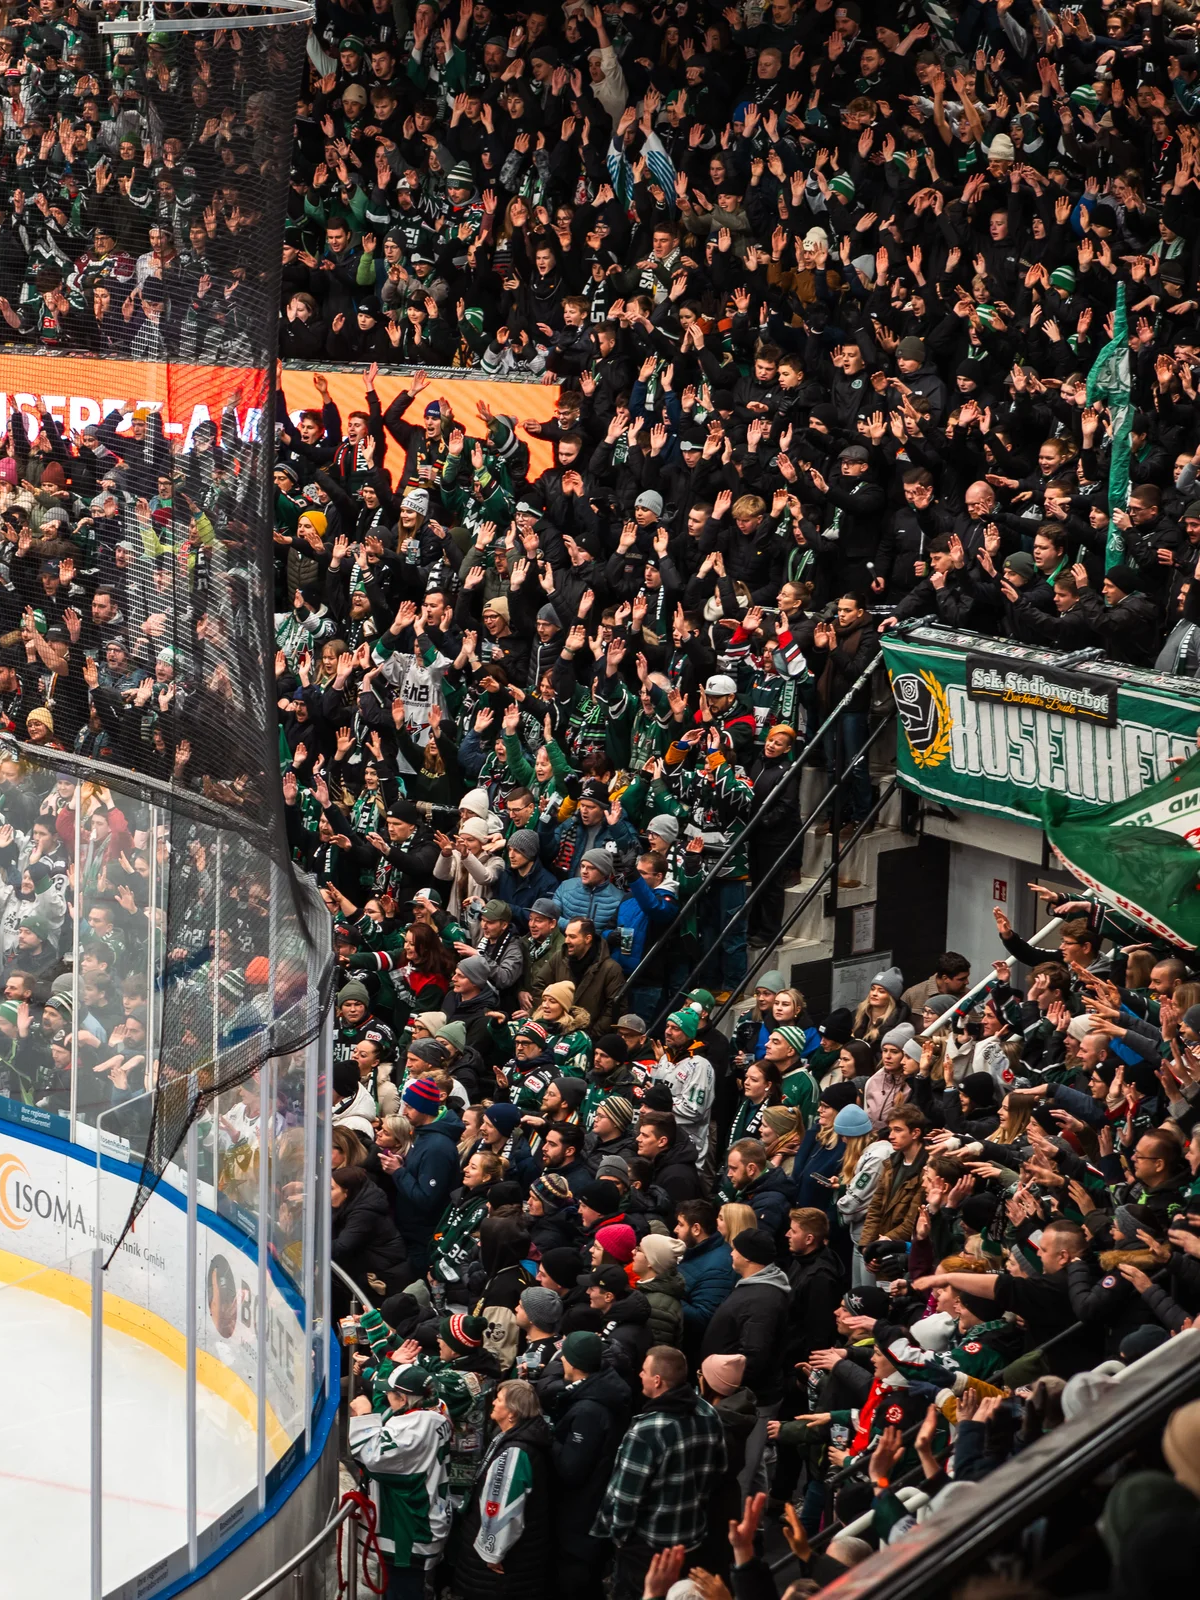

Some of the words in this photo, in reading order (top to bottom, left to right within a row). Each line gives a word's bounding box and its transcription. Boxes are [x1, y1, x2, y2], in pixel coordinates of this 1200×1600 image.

[972, 668, 1004, 691] Sek.
[1004, 672, 1109, 714] Stadionverbot
[15, 1181, 86, 1234] ISOMA
[143, 1249, 165, 1270] GmbH
